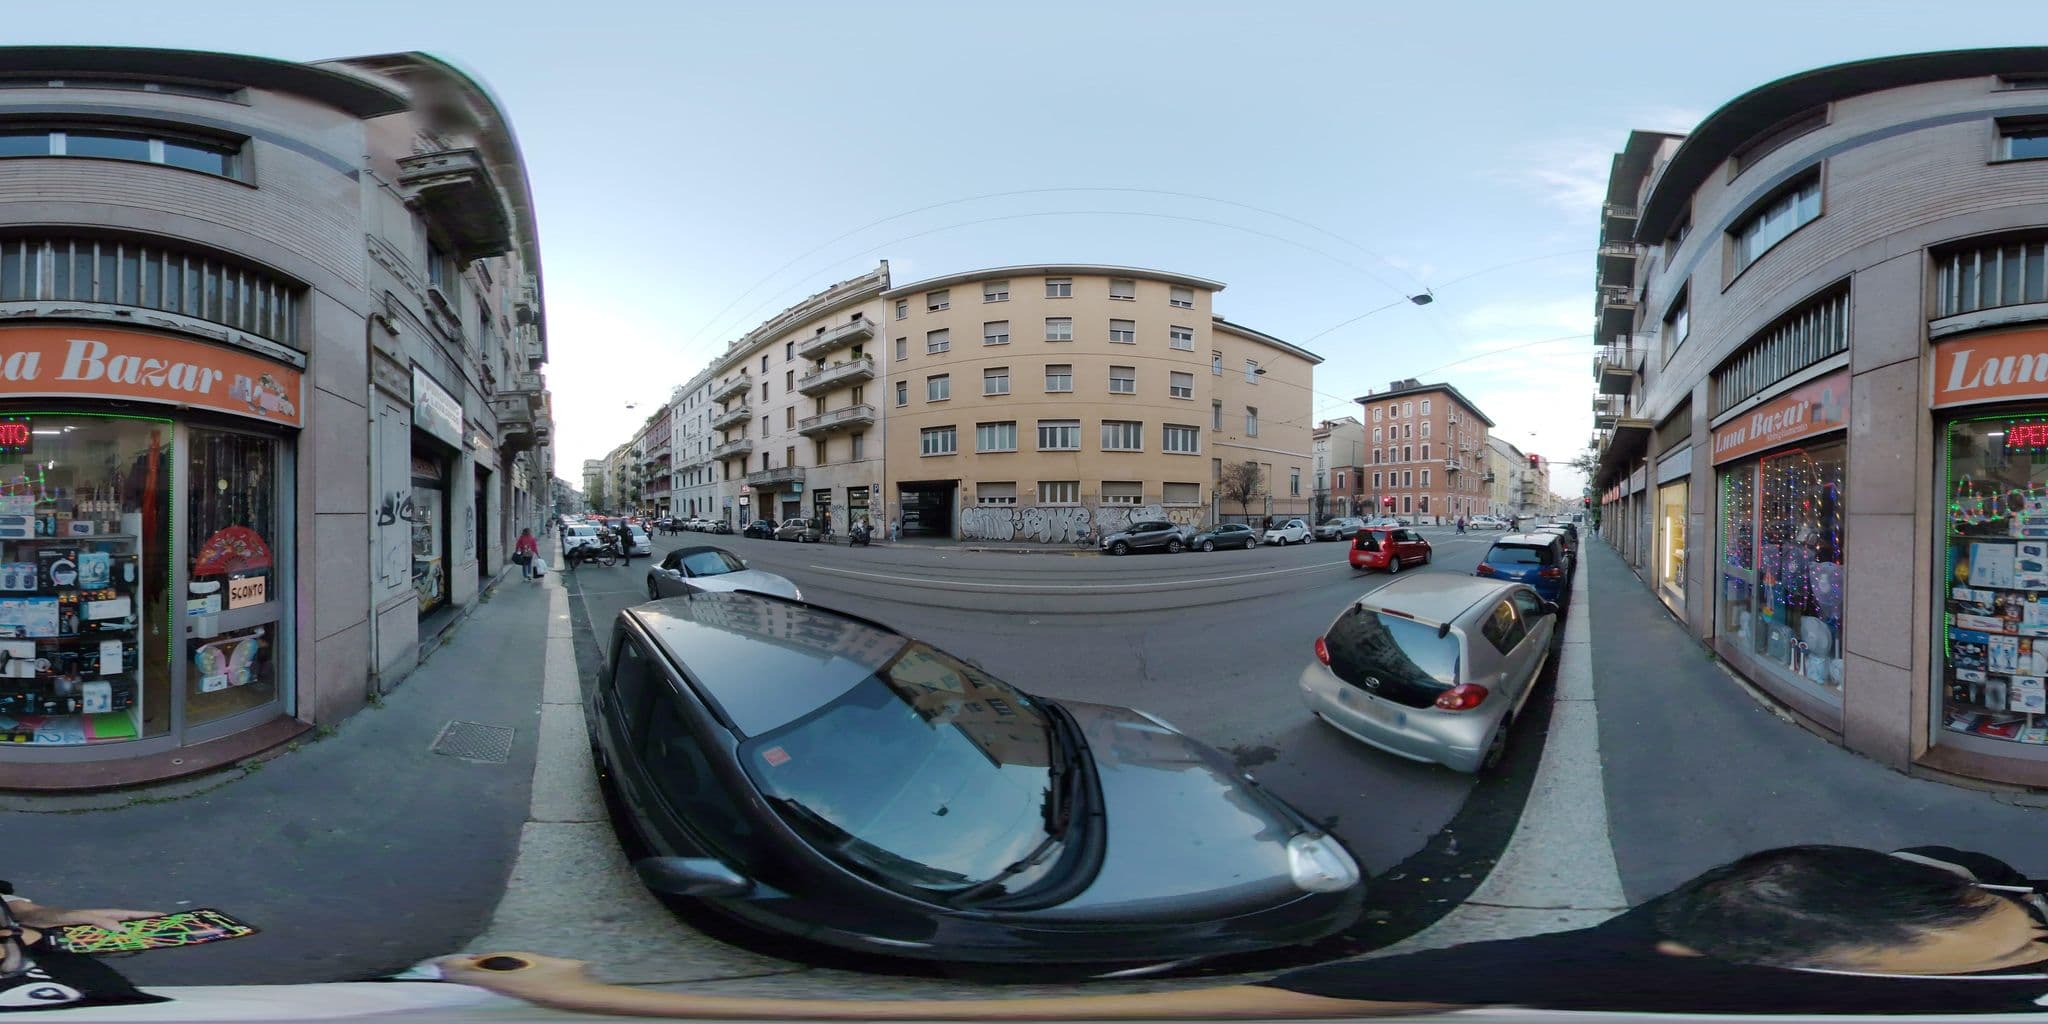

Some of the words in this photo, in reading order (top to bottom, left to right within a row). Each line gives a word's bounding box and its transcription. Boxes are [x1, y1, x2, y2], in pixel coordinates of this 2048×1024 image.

[0, 352, 42, 381] a
[55, 339, 223, 394] Bazar
[1715, 428, 1745, 453] Luna
[1749, 401, 1809, 440] Bazar
[231, 583, 264, 601] SCONTO
